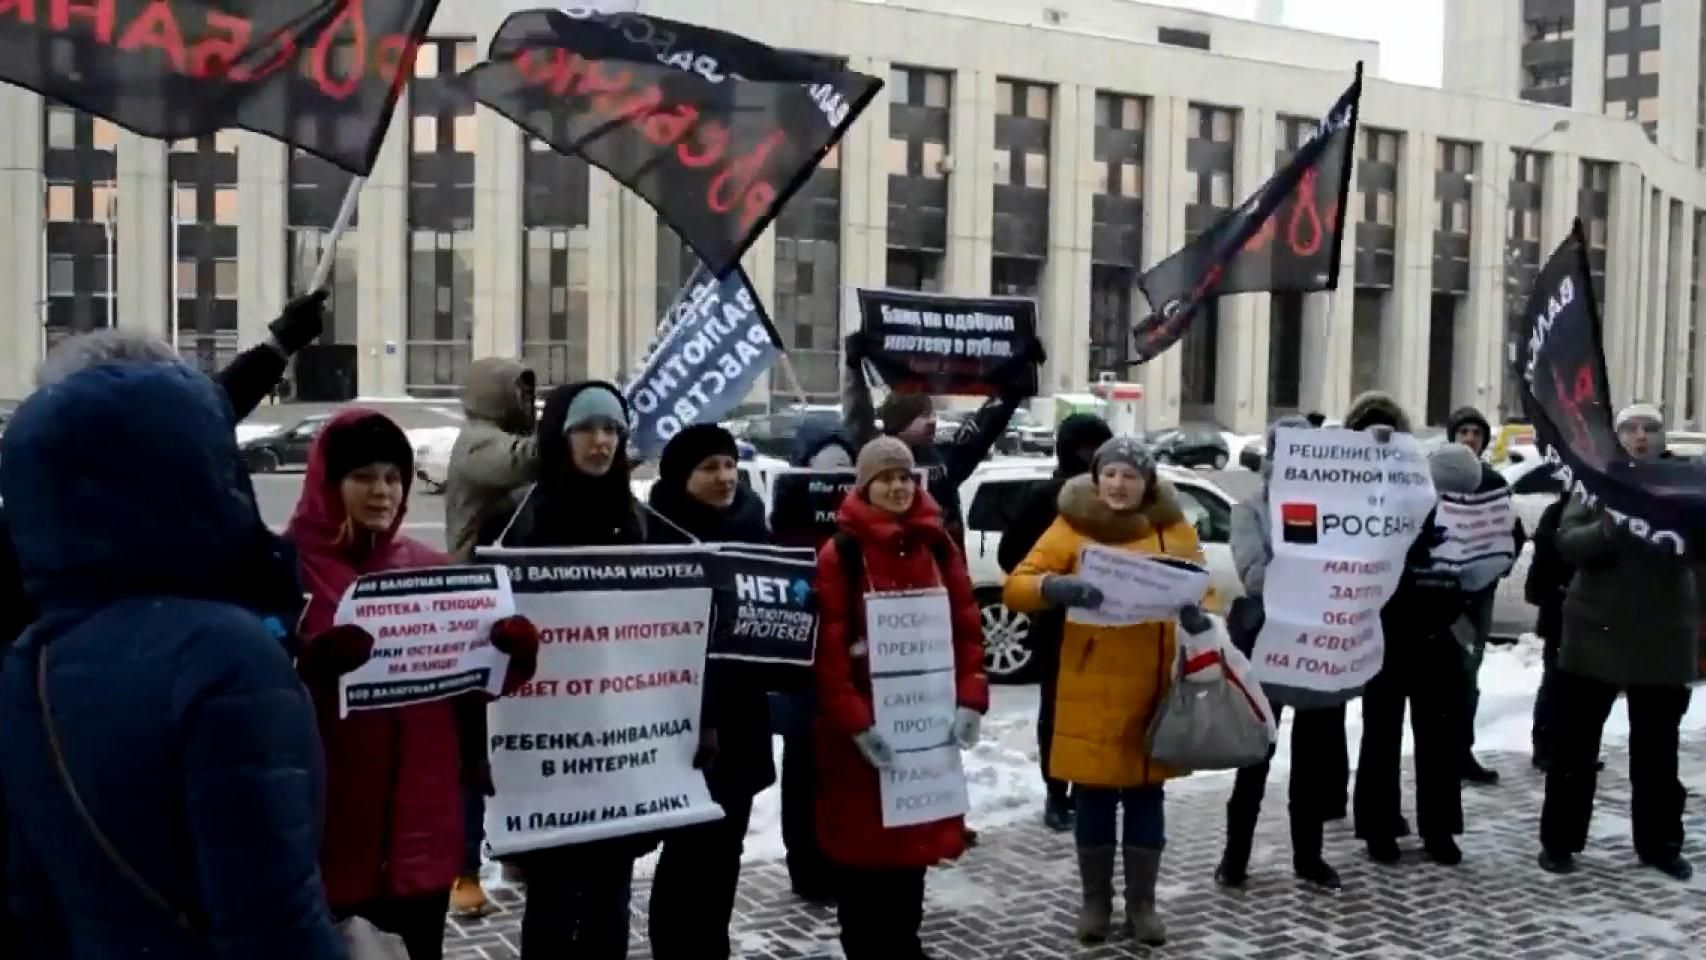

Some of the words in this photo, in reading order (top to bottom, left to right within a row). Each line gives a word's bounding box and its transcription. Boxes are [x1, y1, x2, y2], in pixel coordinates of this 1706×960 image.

[528, 565, 627, 581] ВАЛЮТНАЯ
[630, 563, 705, 580] ИПОТЕКА
[735, 573, 790, 604] НЕТ
[355, 602, 421, 618] ИПОТЕКА
[379, 622, 437, 638] ВАЛЮТА
[614, 621, 704, 641] ИПОТЕКА?
[565, 679, 594, 697] ОТ
[491, 717, 692, 752] РЕБЕНКА-ИНВАЛИДА
[541, 759, 556, 777] В
[563, 748, 659, 775] ИНТЕРНАТ
[506, 815, 522, 832] И
[528, 807, 596, 830] ПАШИ
[602, 806, 629, 821] НА
[634, 794, 692, 817] БАНК!
